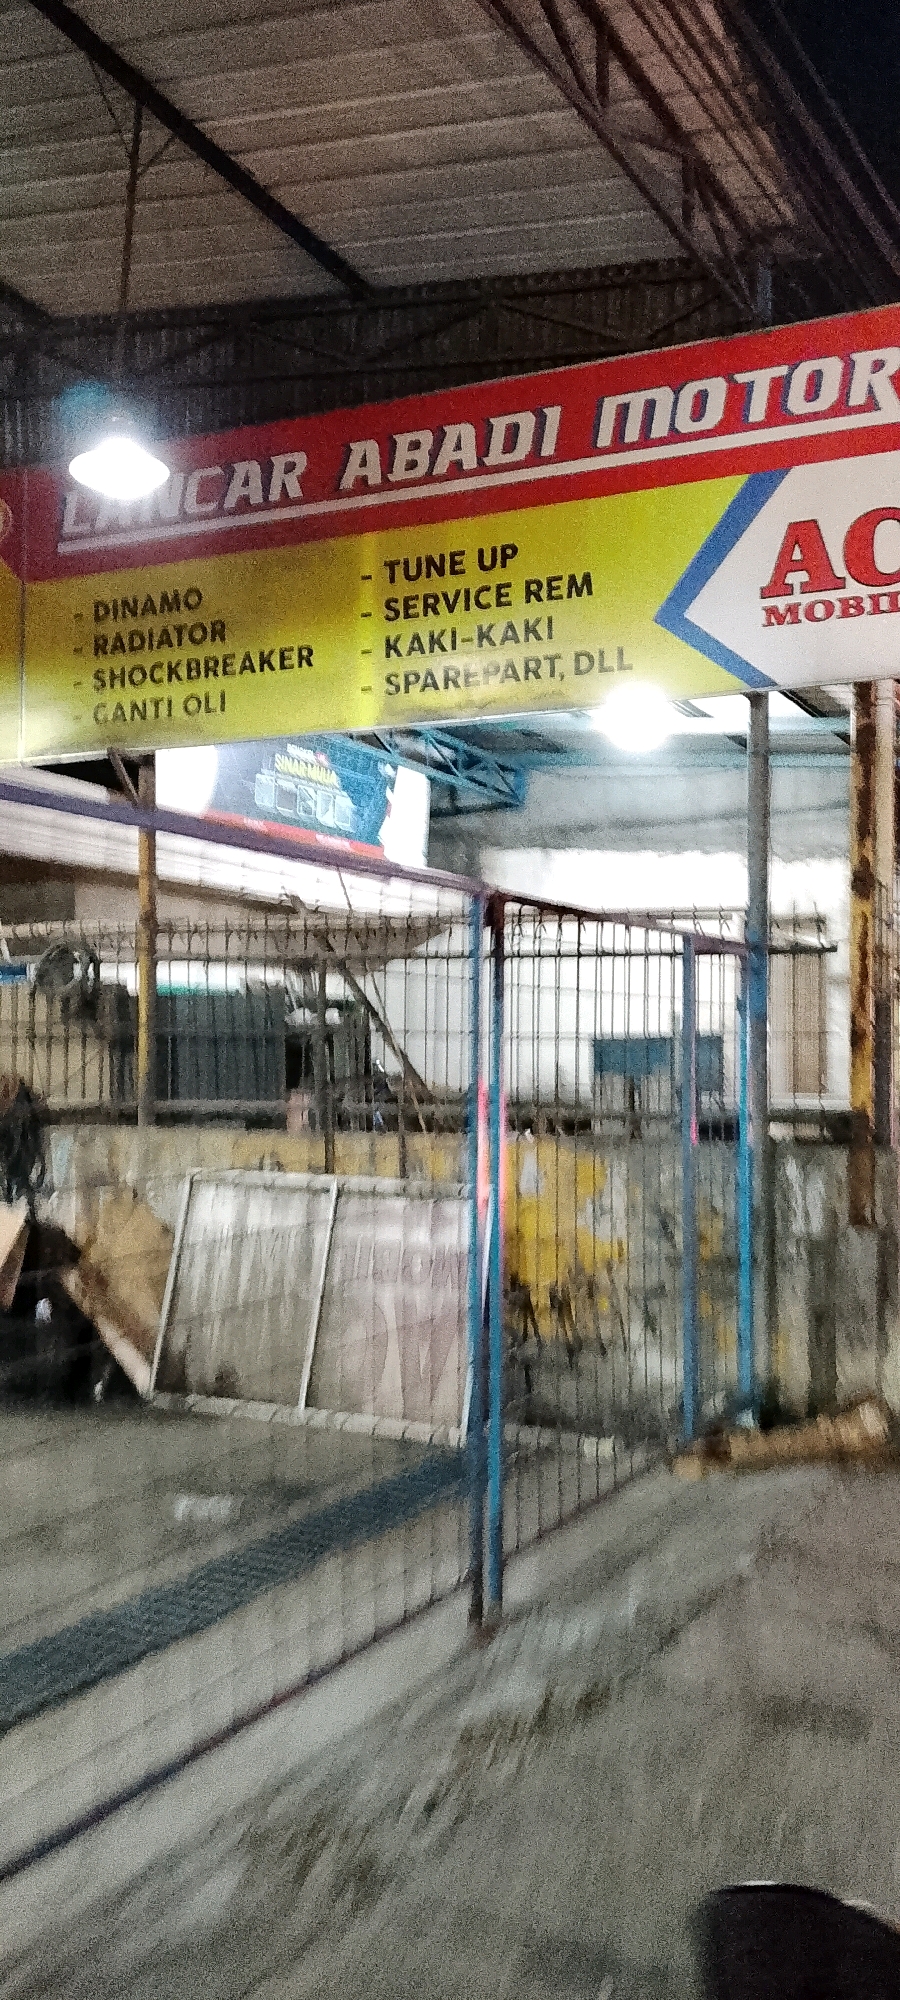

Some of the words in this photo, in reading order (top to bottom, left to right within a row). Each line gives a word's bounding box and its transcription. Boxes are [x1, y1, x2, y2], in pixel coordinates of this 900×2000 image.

[339, 405, 562, 490] ABADI
[592, 346, 900, 450] MOTOR
[384, 549, 467, 584] TUNE
[477, 543, 519, 572] UP
[93, 586, 204, 623] DINAMO
[384, 581, 513, 622] SERVICE
[524, 571, 594, 604] REM
[93, 619, 226, 657] RADIATOR
[384, 615, 554, 659] KAKI-KAKI
[93, 645, 314, 691] SHOCKBREAKER
[384, 652, 565, 696] SPAREPART,
[573, 646, 634, 677] DLL
[183, 689, 227, 717] OLI
